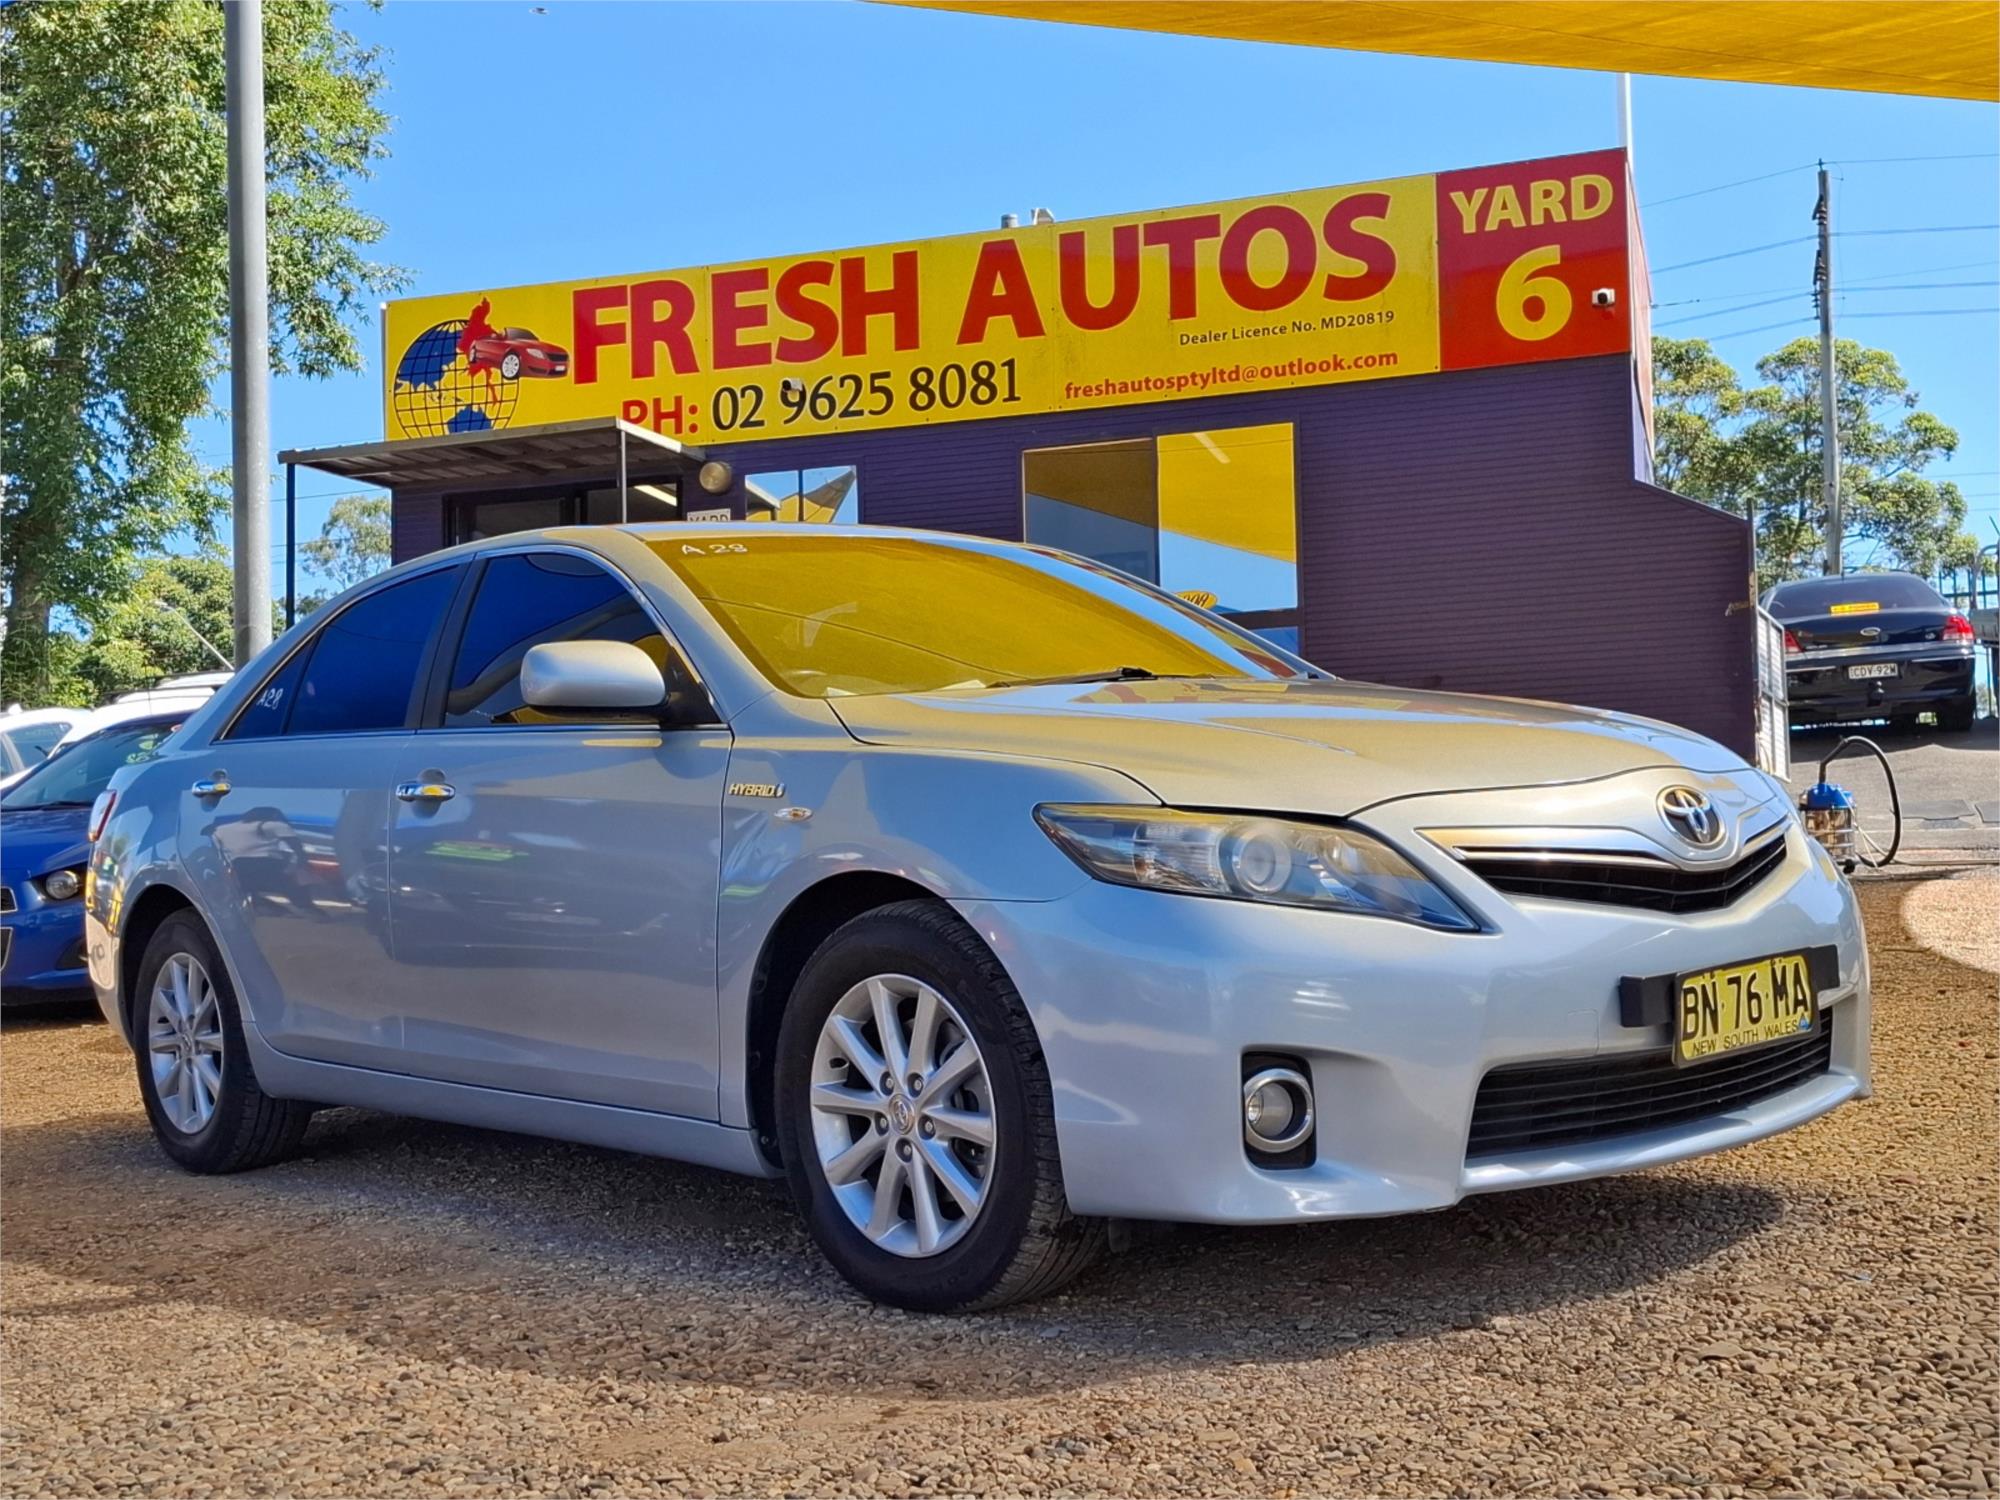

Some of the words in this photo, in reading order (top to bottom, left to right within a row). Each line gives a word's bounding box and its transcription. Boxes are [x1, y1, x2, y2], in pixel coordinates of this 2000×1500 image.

[1449, 174, 1614, 234] YARD
[573, 250, 920, 384] FRESH
[956, 191, 1397, 345] AUTOS
[1496, 244, 1573, 341] 6
[1180, 330, 1227, 345] Dealer
[1232, 324, 1287, 340] Licence
[1292, 320, 1317, 333] No.
[1321, 311, 1395, 329] MD20819
[622, 395, 698, 434] PH:
[712, 384, 765, 430] 02
[779, 371, 894, 425] 9625
[908, 358, 1021, 411] 8081
[1065, 352, 1398, 399] freshautosptyltd@outlook.com
[728, 783, 776, 797] HYBRID
[1682, 981, 1719, 1040] BN
[1727, 972, 1763, 1030] 76
[1771, 962, 1809, 1019] MA
[1693, 1038, 1717, 1056] NEW
[1723, 1030, 1759, 1049] SOUTH
[1764, 1019, 1798, 1040] WALES
